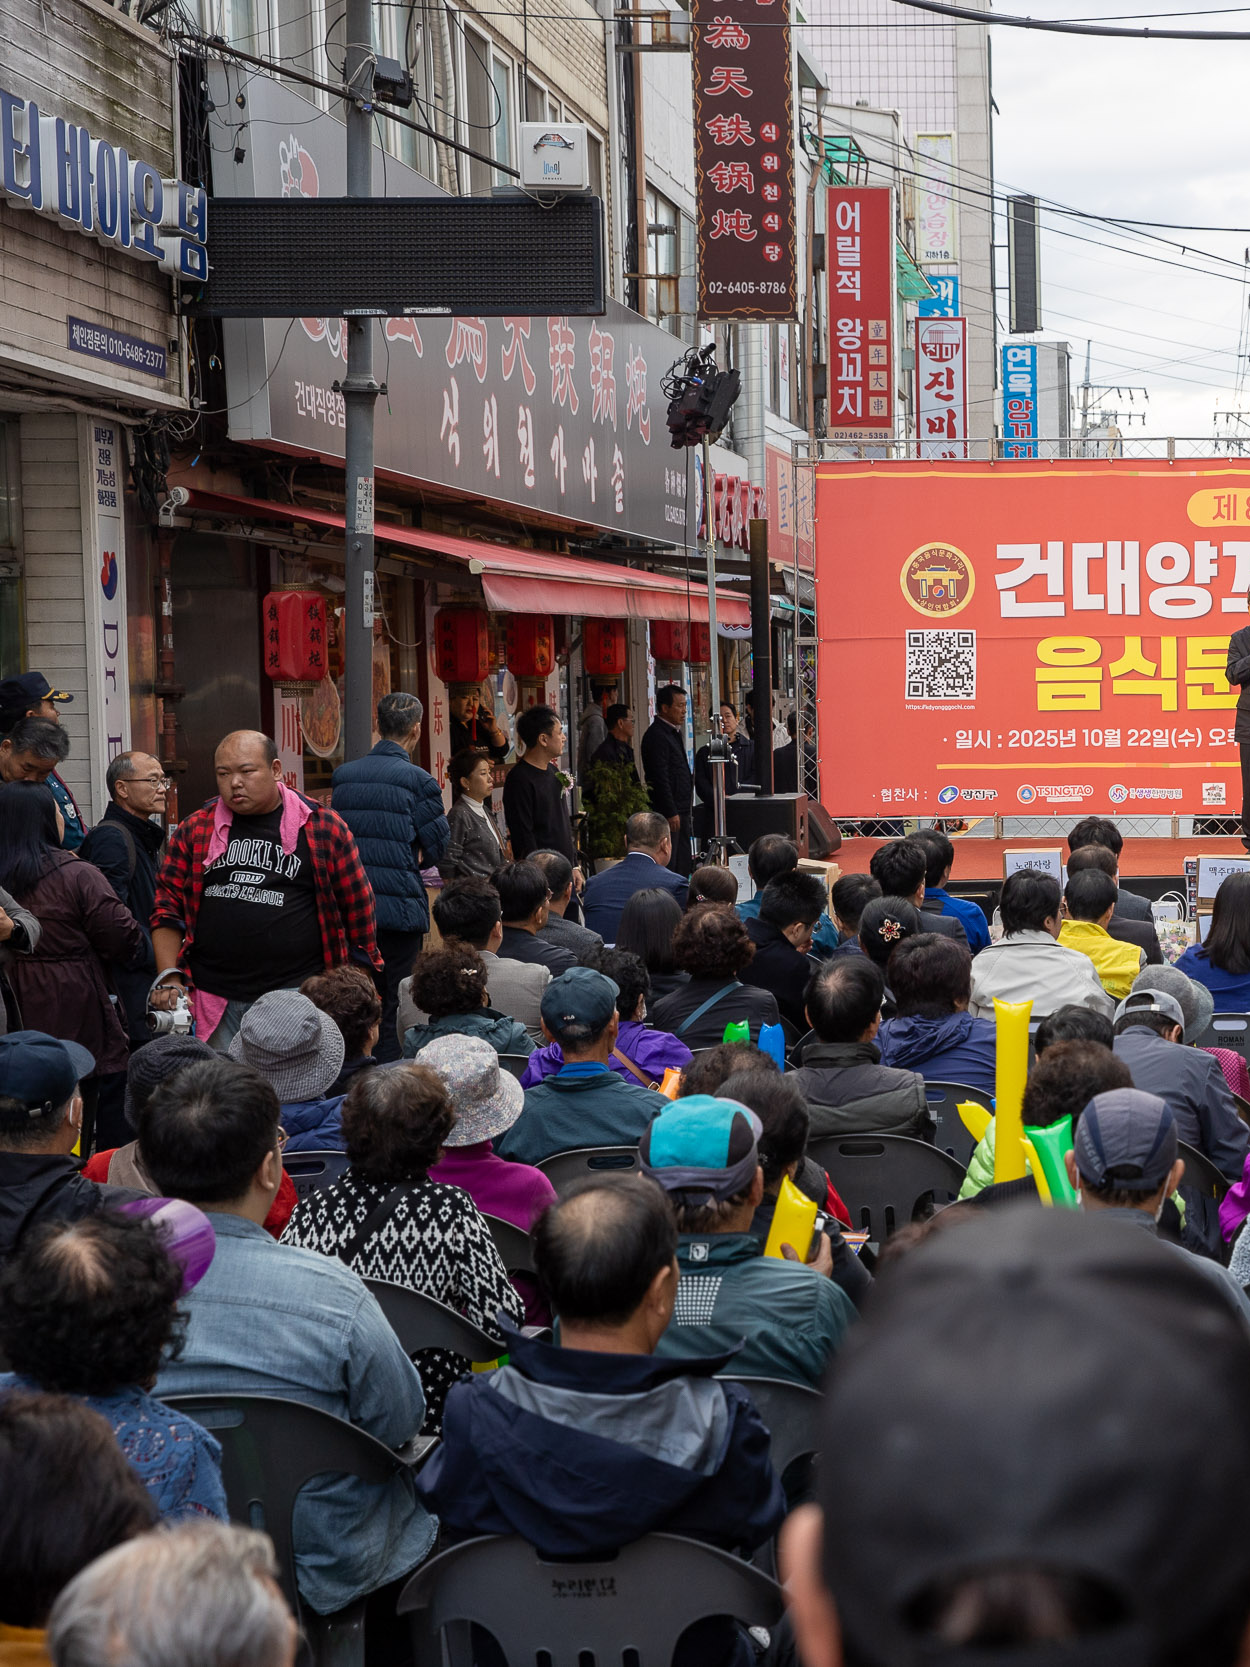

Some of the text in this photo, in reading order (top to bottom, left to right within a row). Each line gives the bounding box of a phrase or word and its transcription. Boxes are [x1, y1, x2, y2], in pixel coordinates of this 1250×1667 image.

[761, 124, 781, 261] 식위천식당
[709, 281, 787, 294] 02-6405-8786
[835, 201, 864, 418] 어릴적 왕꼬치
[72, 323, 164, 370] 체인점문의 010-6486-2377
[926, 344, 957, 359] 진미
[871, 322, 884, 415] 童年大串
[294, 380, 346, 428] 건대직영점
[834, 431, 889, 440] 02)462-5358
[98, 448, 111, 466] 전용
[96, 468, 115, 487] 기능성
[911, 549, 965, 569] 중국음식문화거리
[103, 620, 119, 706] Dr.
[955, 729, 992, 750] 일시
[1008, 730, 1076, 749] 2025년
[1082, 728, 1122, 748] 10월
[1128, 728, 1203, 748] 22일(수)
[880, 787, 919, 802] 협찬사
[961, 789, 999, 800] 광진구
[1036, 785, 1094, 798] TSINGTAO
[203, 839, 301, 880] ROOKLYN
[1015, 859, 1052, 871] 노래자랑
[234, 873, 262, 883] URBAN
[240, 885, 285, 906] LEAGUE
